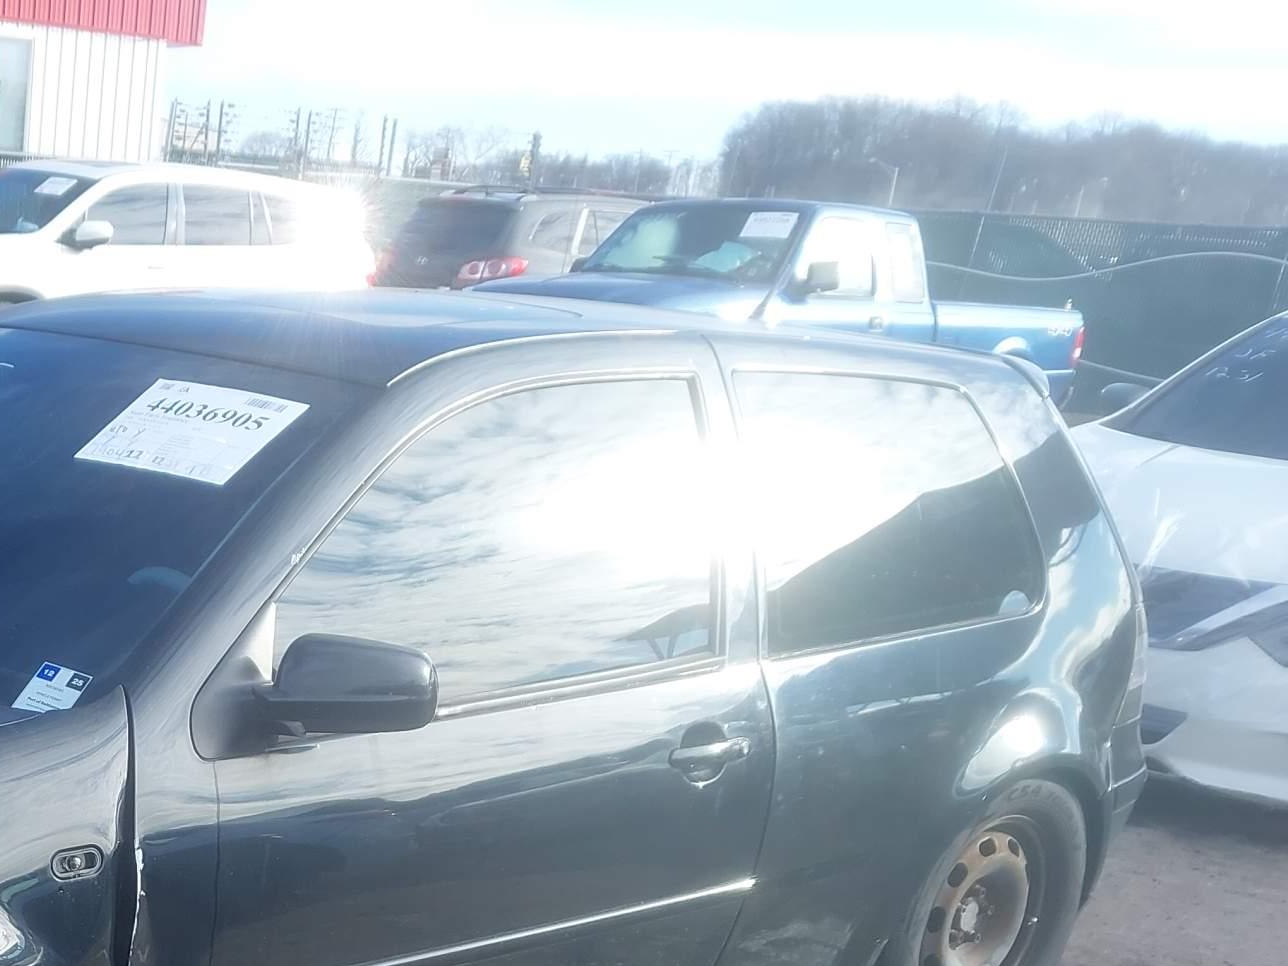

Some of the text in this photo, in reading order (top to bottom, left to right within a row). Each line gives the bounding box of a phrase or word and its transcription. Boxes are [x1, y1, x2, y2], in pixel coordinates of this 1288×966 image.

[146, 397, 271, 431] 44036905
[43, 668, 56, 677] 12
[71, 678, 85, 687] 25
